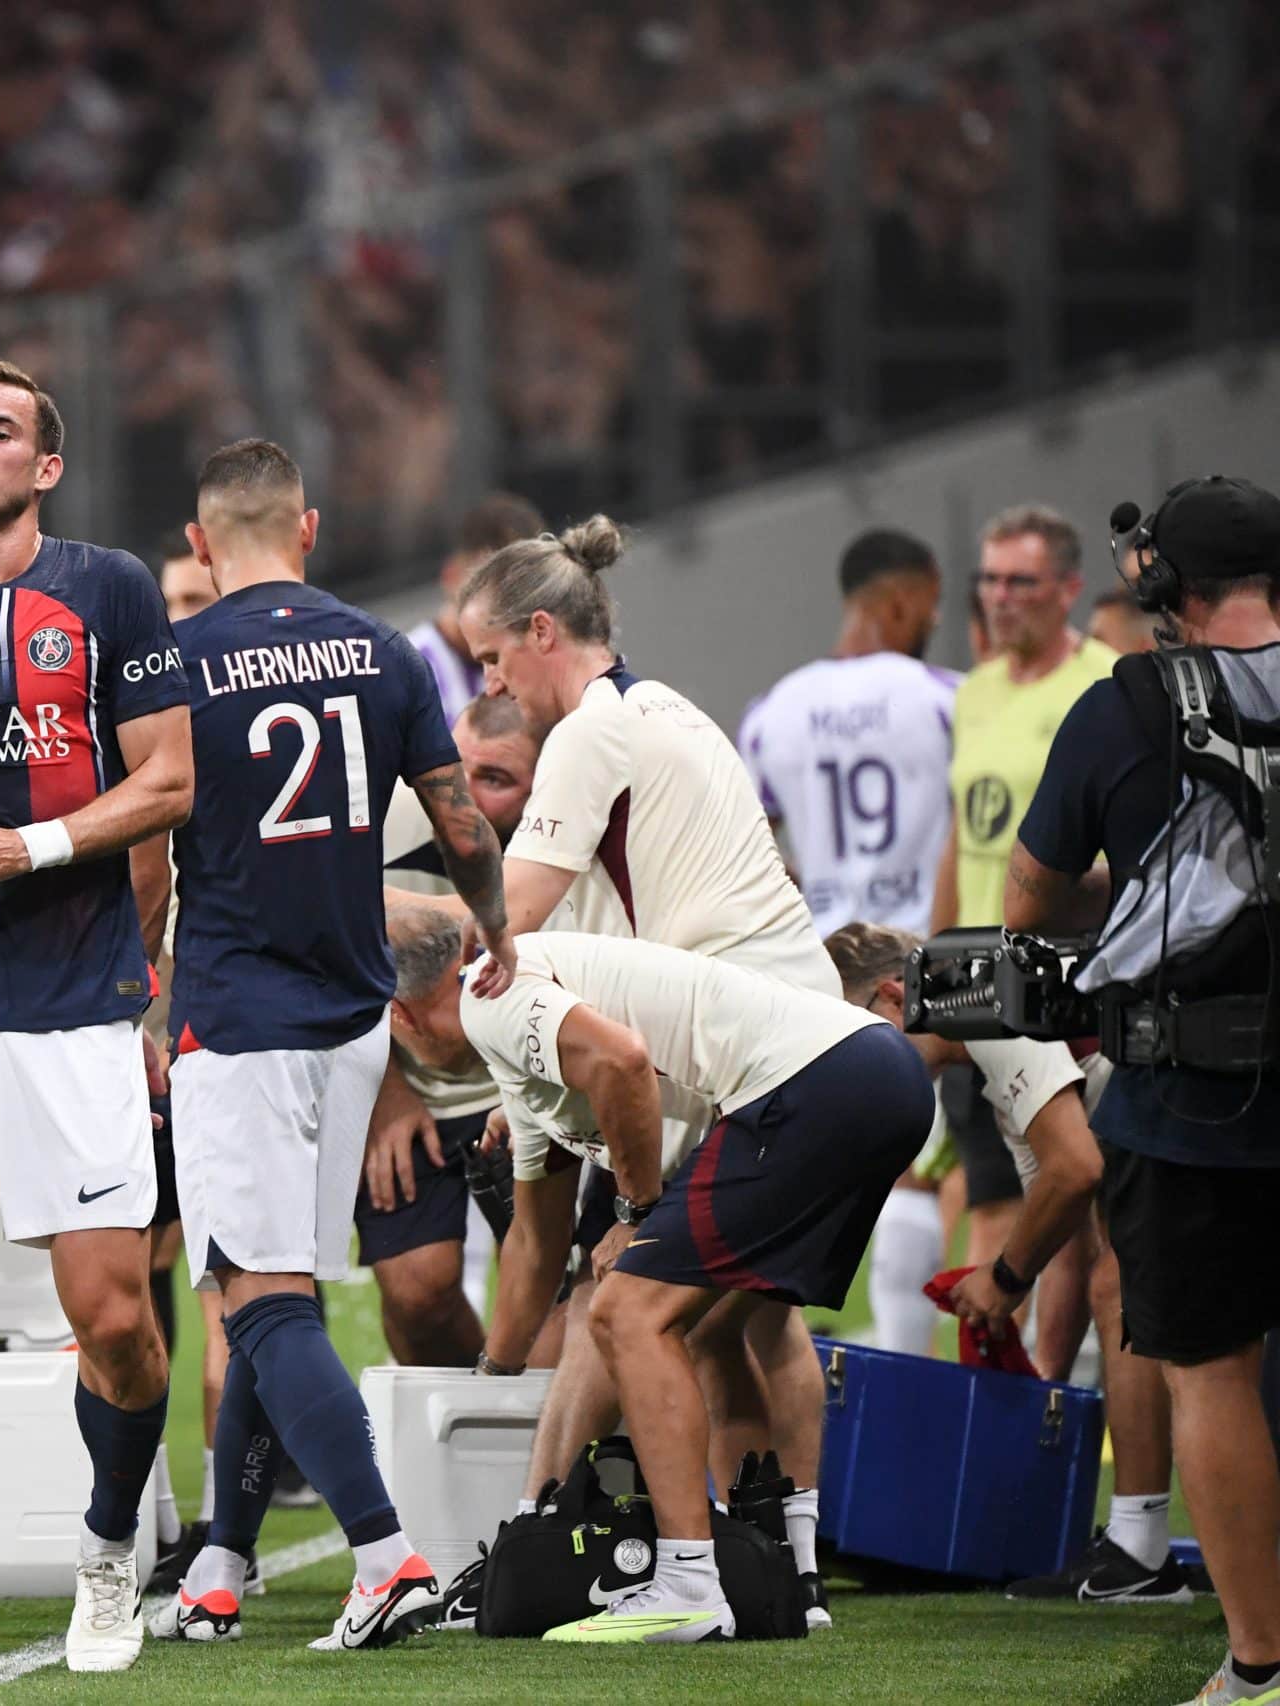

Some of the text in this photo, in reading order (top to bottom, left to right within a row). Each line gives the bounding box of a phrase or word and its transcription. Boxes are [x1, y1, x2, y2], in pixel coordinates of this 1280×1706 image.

[122, 647, 185, 683] GOAT
[201, 638, 381, 697] L.HERNANDEZ
[248, 695, 372, 845] 21
[815, 754, 898, 862] 19
[526, 998, 548, 1074] GOAT
[241, 1434, 271, 1494] PARIS
